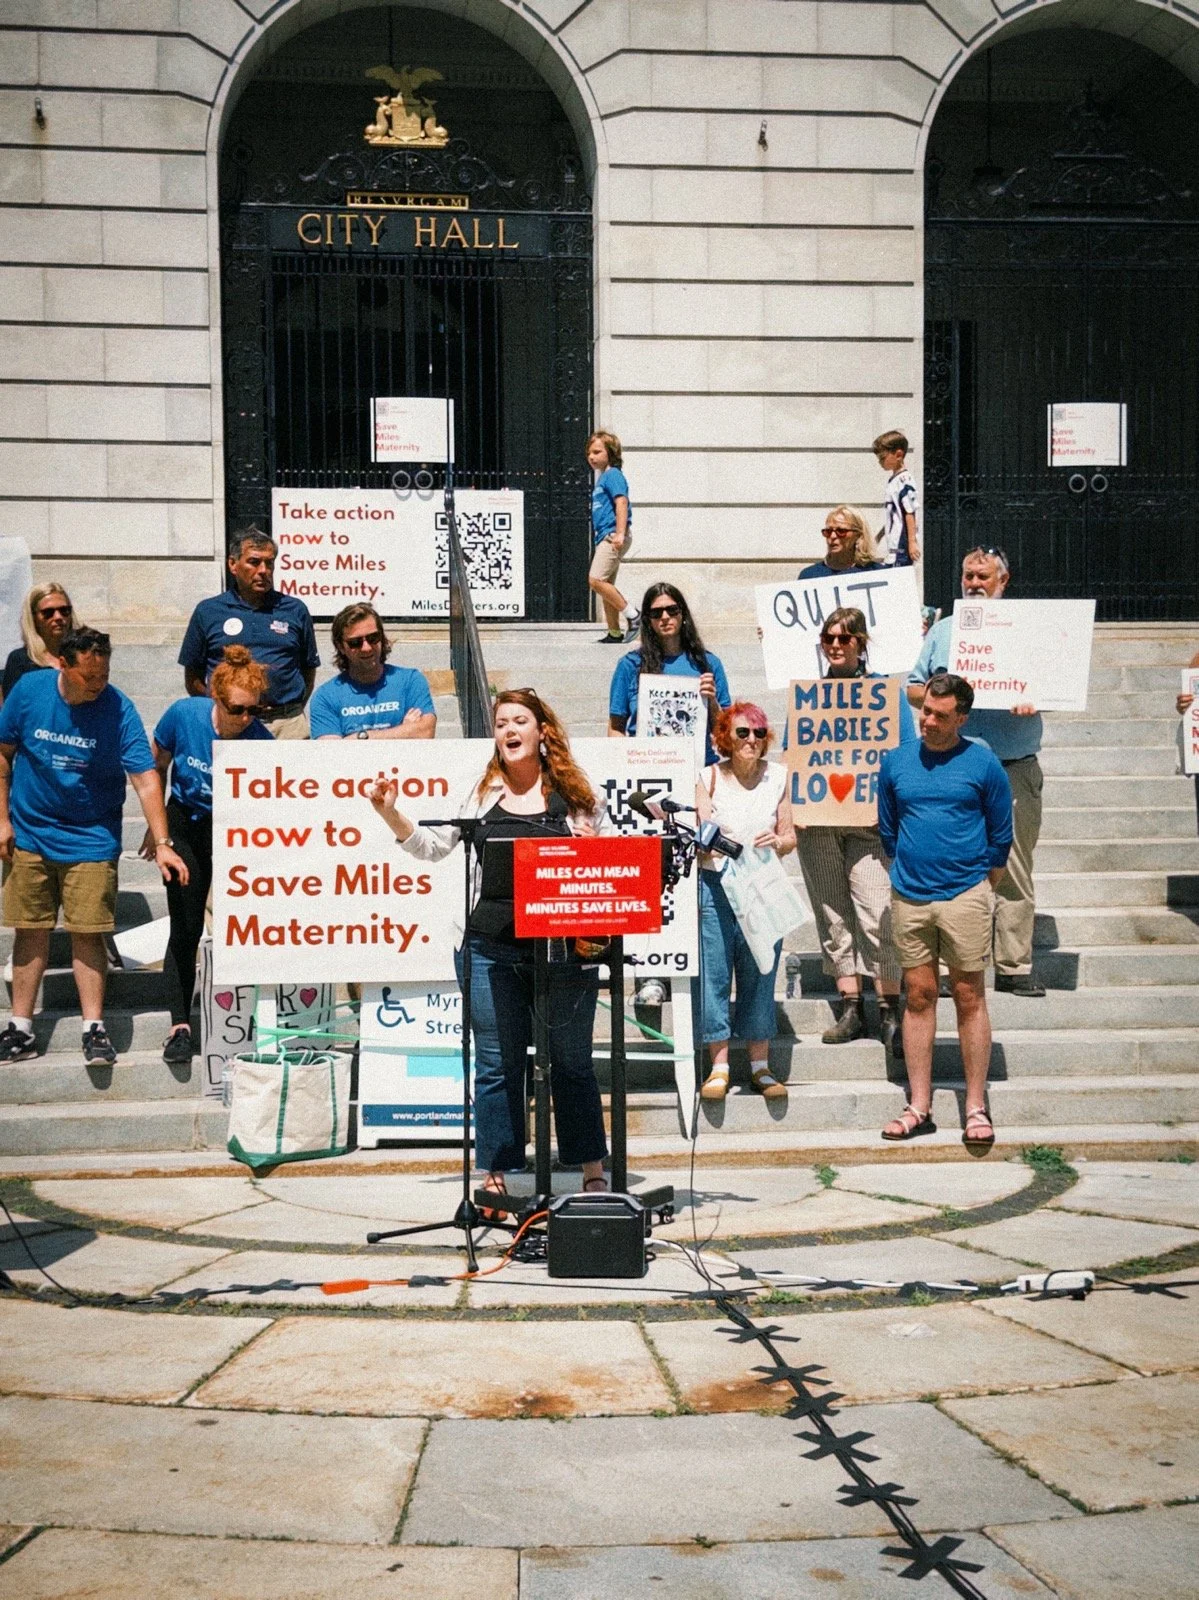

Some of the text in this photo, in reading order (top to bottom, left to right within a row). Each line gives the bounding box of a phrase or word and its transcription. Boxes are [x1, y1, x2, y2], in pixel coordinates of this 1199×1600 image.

[297, 213, 519, 249] CITY HALL
[279, 502, 395, 520] Take action
[279, 531, 350, 545] now to
[280, 554, 387, 571] Save Miles
[280, 579, 385, 600] Maternity.
[958, 641, 993, 655] Save
[956, 659, 995, 673] Miles
[962, 677, 1027, 693] aternity
[794, 682, 887, 711] MILES
[341, 701, 400, 717] ORGANIZER
[34, 728, 97, 749] ORGANIZER
[797, 716, 890, 746] BABIES
[808, 749, 843, 767] ARE
[225, 766, 319, 799] Take
[226, 821, 362, 848] now to
[226, 862, 432, 897] Save Miles
[536, 866, 640, 879] MILES CAN MEAN
[560, 882, 617, 894] MINUTES.
[526, 900, 651, 914] MINUTES SAVE LIVES.
[226, 913, 430, 953] Maternity.
